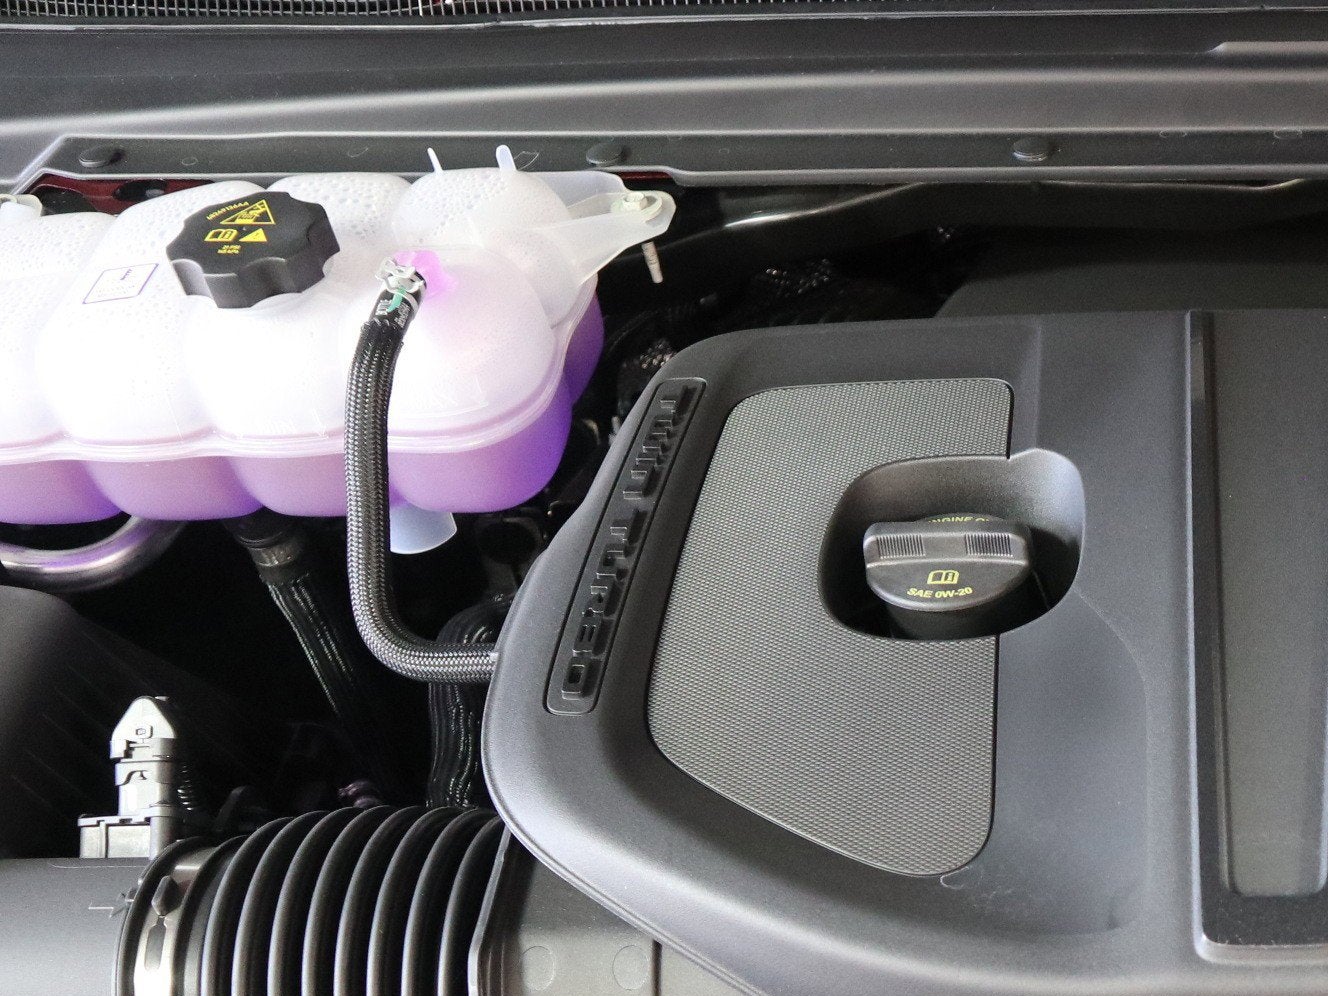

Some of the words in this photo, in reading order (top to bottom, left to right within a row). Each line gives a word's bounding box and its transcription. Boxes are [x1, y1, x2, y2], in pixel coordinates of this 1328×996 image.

[561, 509, 648, 700] TURBO
[907, 587, 934, 598] SAE
[935, 586, 973, 598] 0W-20
